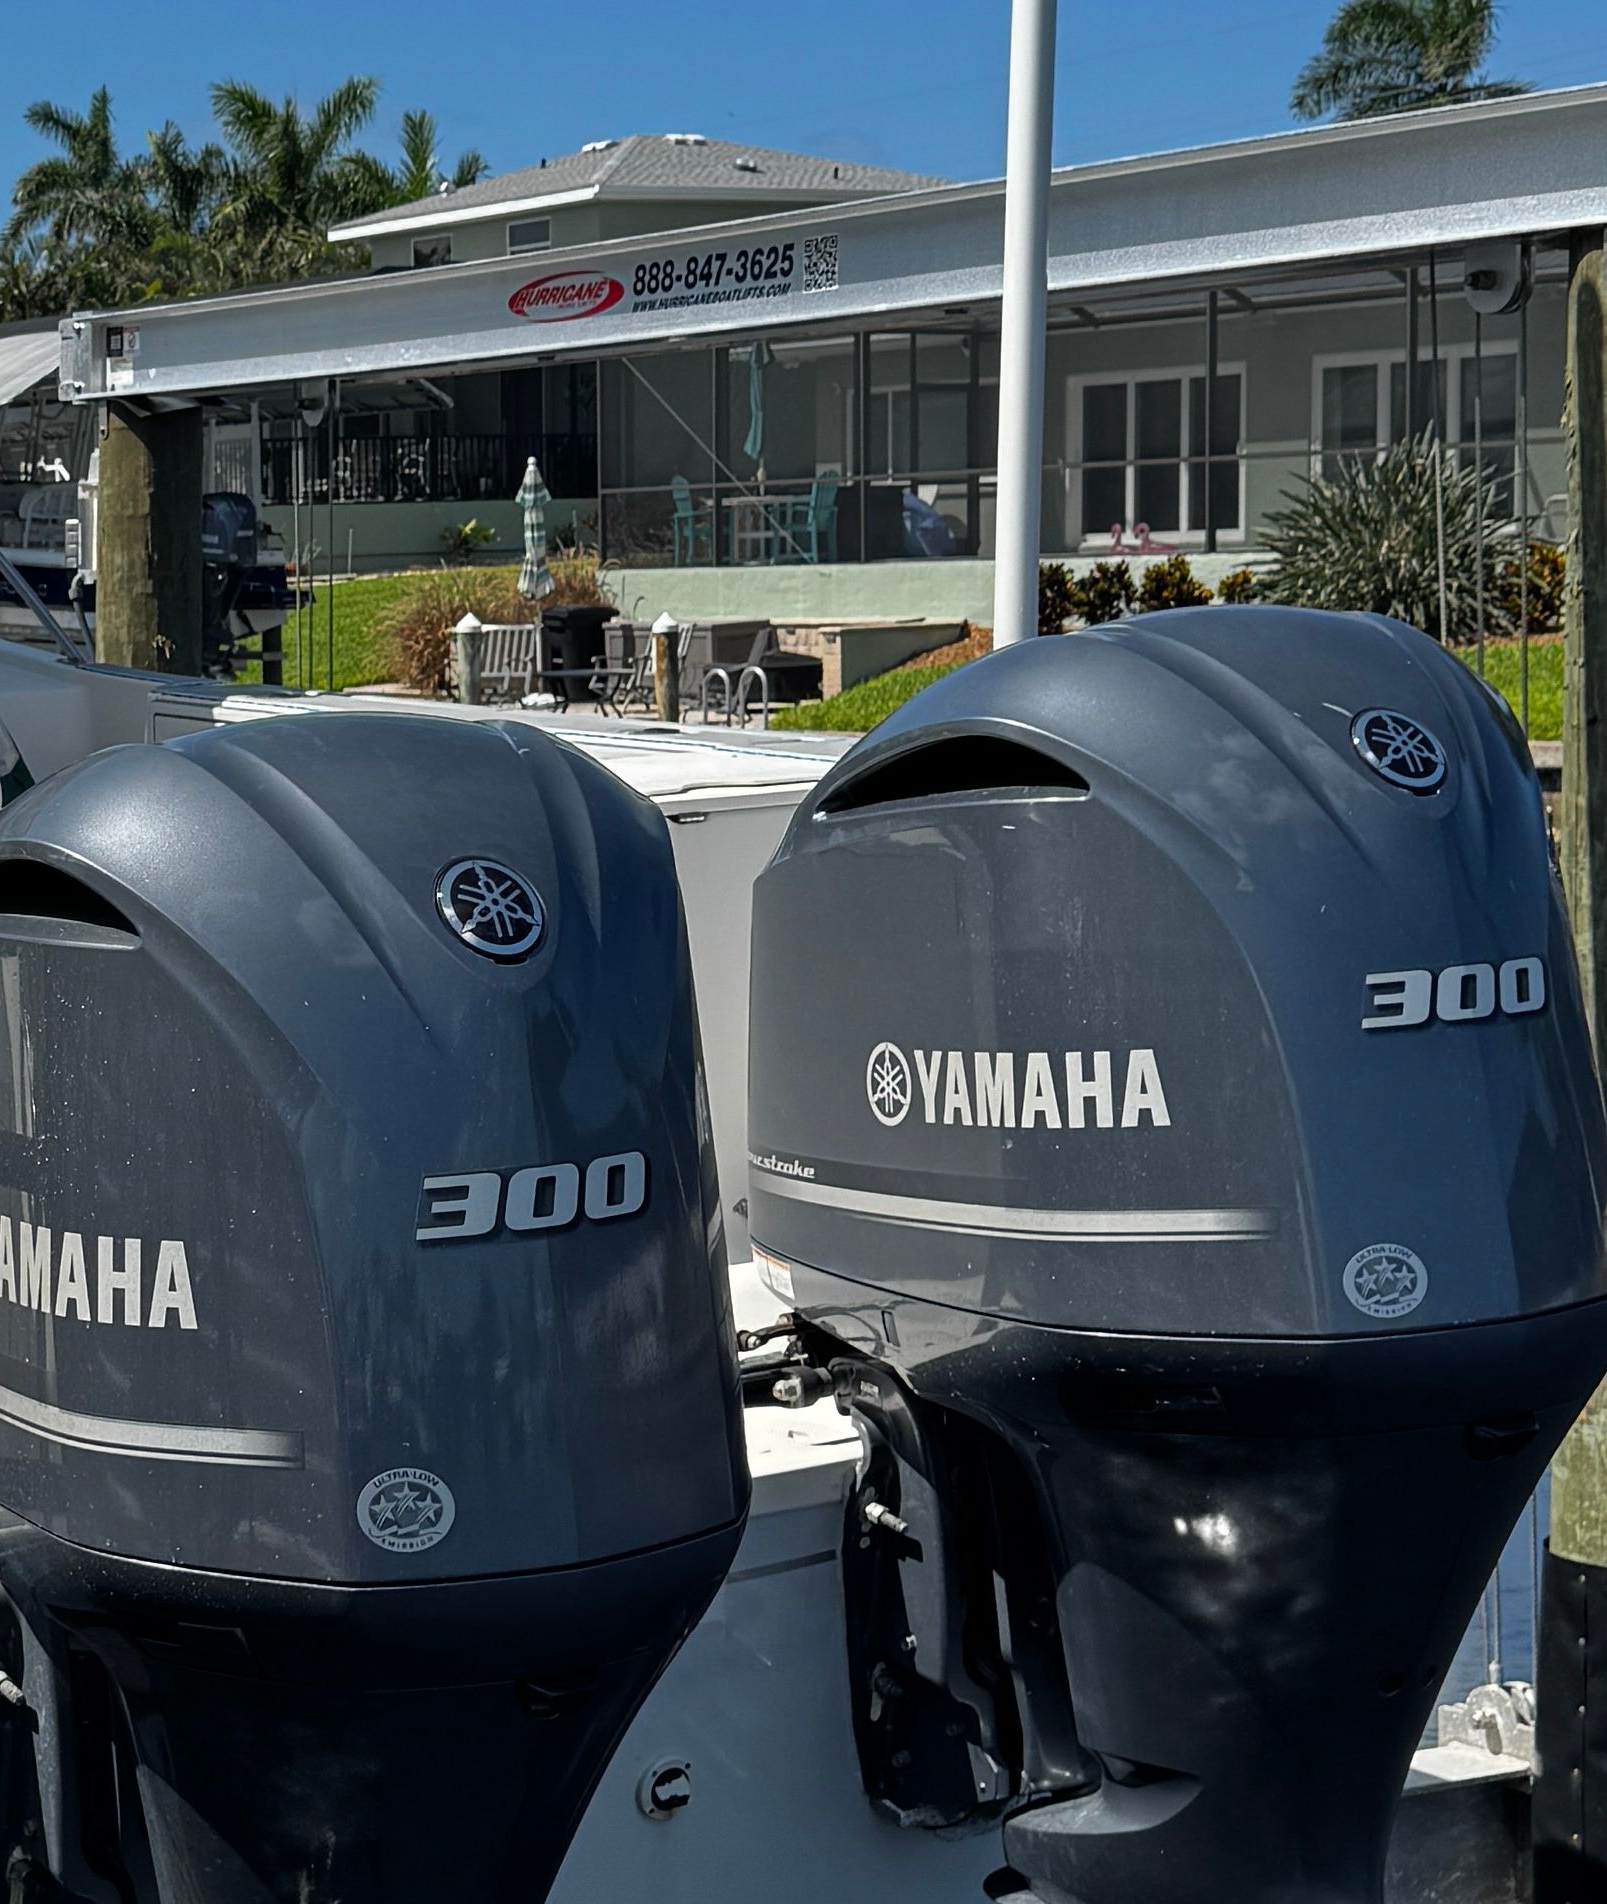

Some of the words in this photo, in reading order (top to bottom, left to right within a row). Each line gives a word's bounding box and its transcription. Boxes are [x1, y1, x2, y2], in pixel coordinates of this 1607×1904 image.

[514, 280, 607, 311] HURRICANE
[633, 243, 794, 296] 888-847-3625
[1361, 957, 1545, 1029] 300
[913, 1049, 1171, 1129] YAMAHA
[416, 1151, 645, 1241] 300
